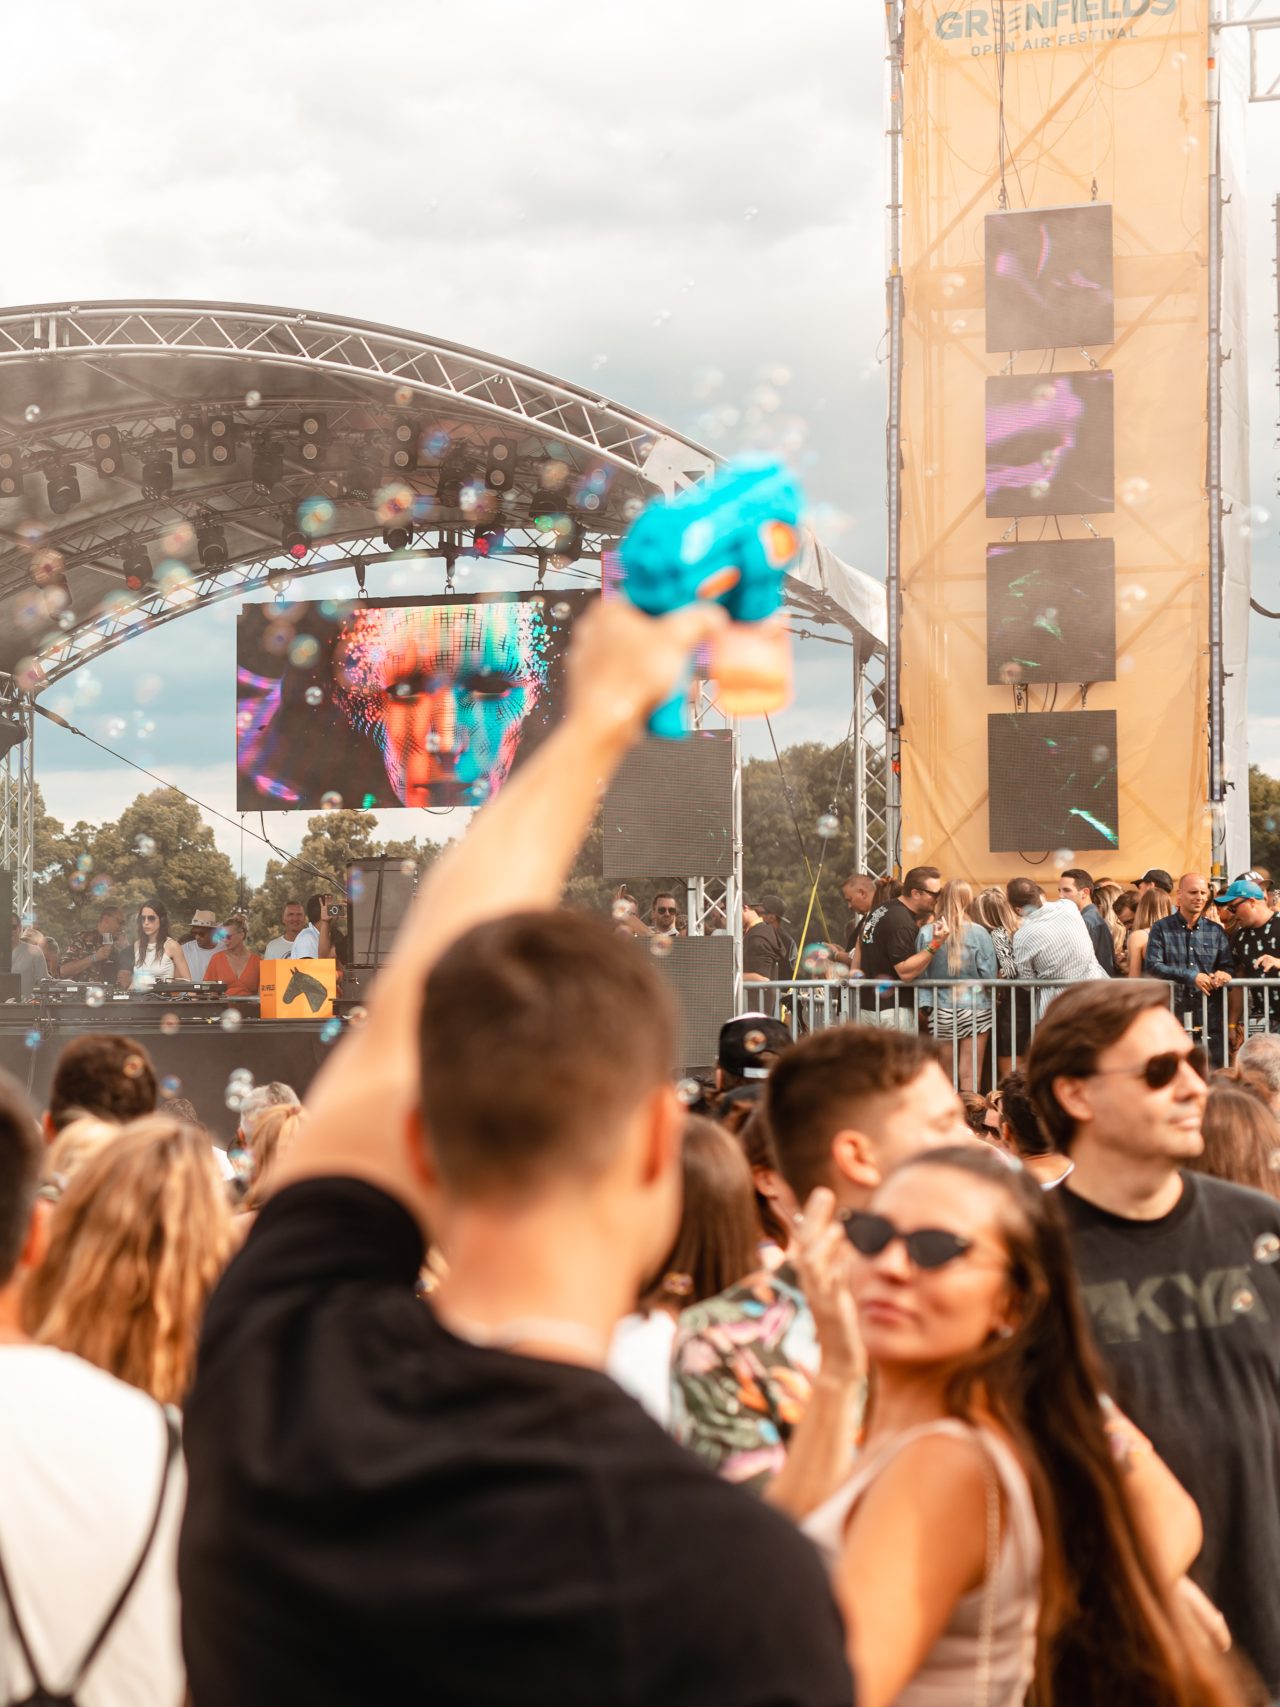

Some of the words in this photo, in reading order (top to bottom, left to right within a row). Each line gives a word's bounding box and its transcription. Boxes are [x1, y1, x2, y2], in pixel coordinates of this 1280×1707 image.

[971, 42, 1016, 56] OPEN
[1023, 39, 1051, 50] AIR
[1058, 28, 1138, 46] FESTIVAL
